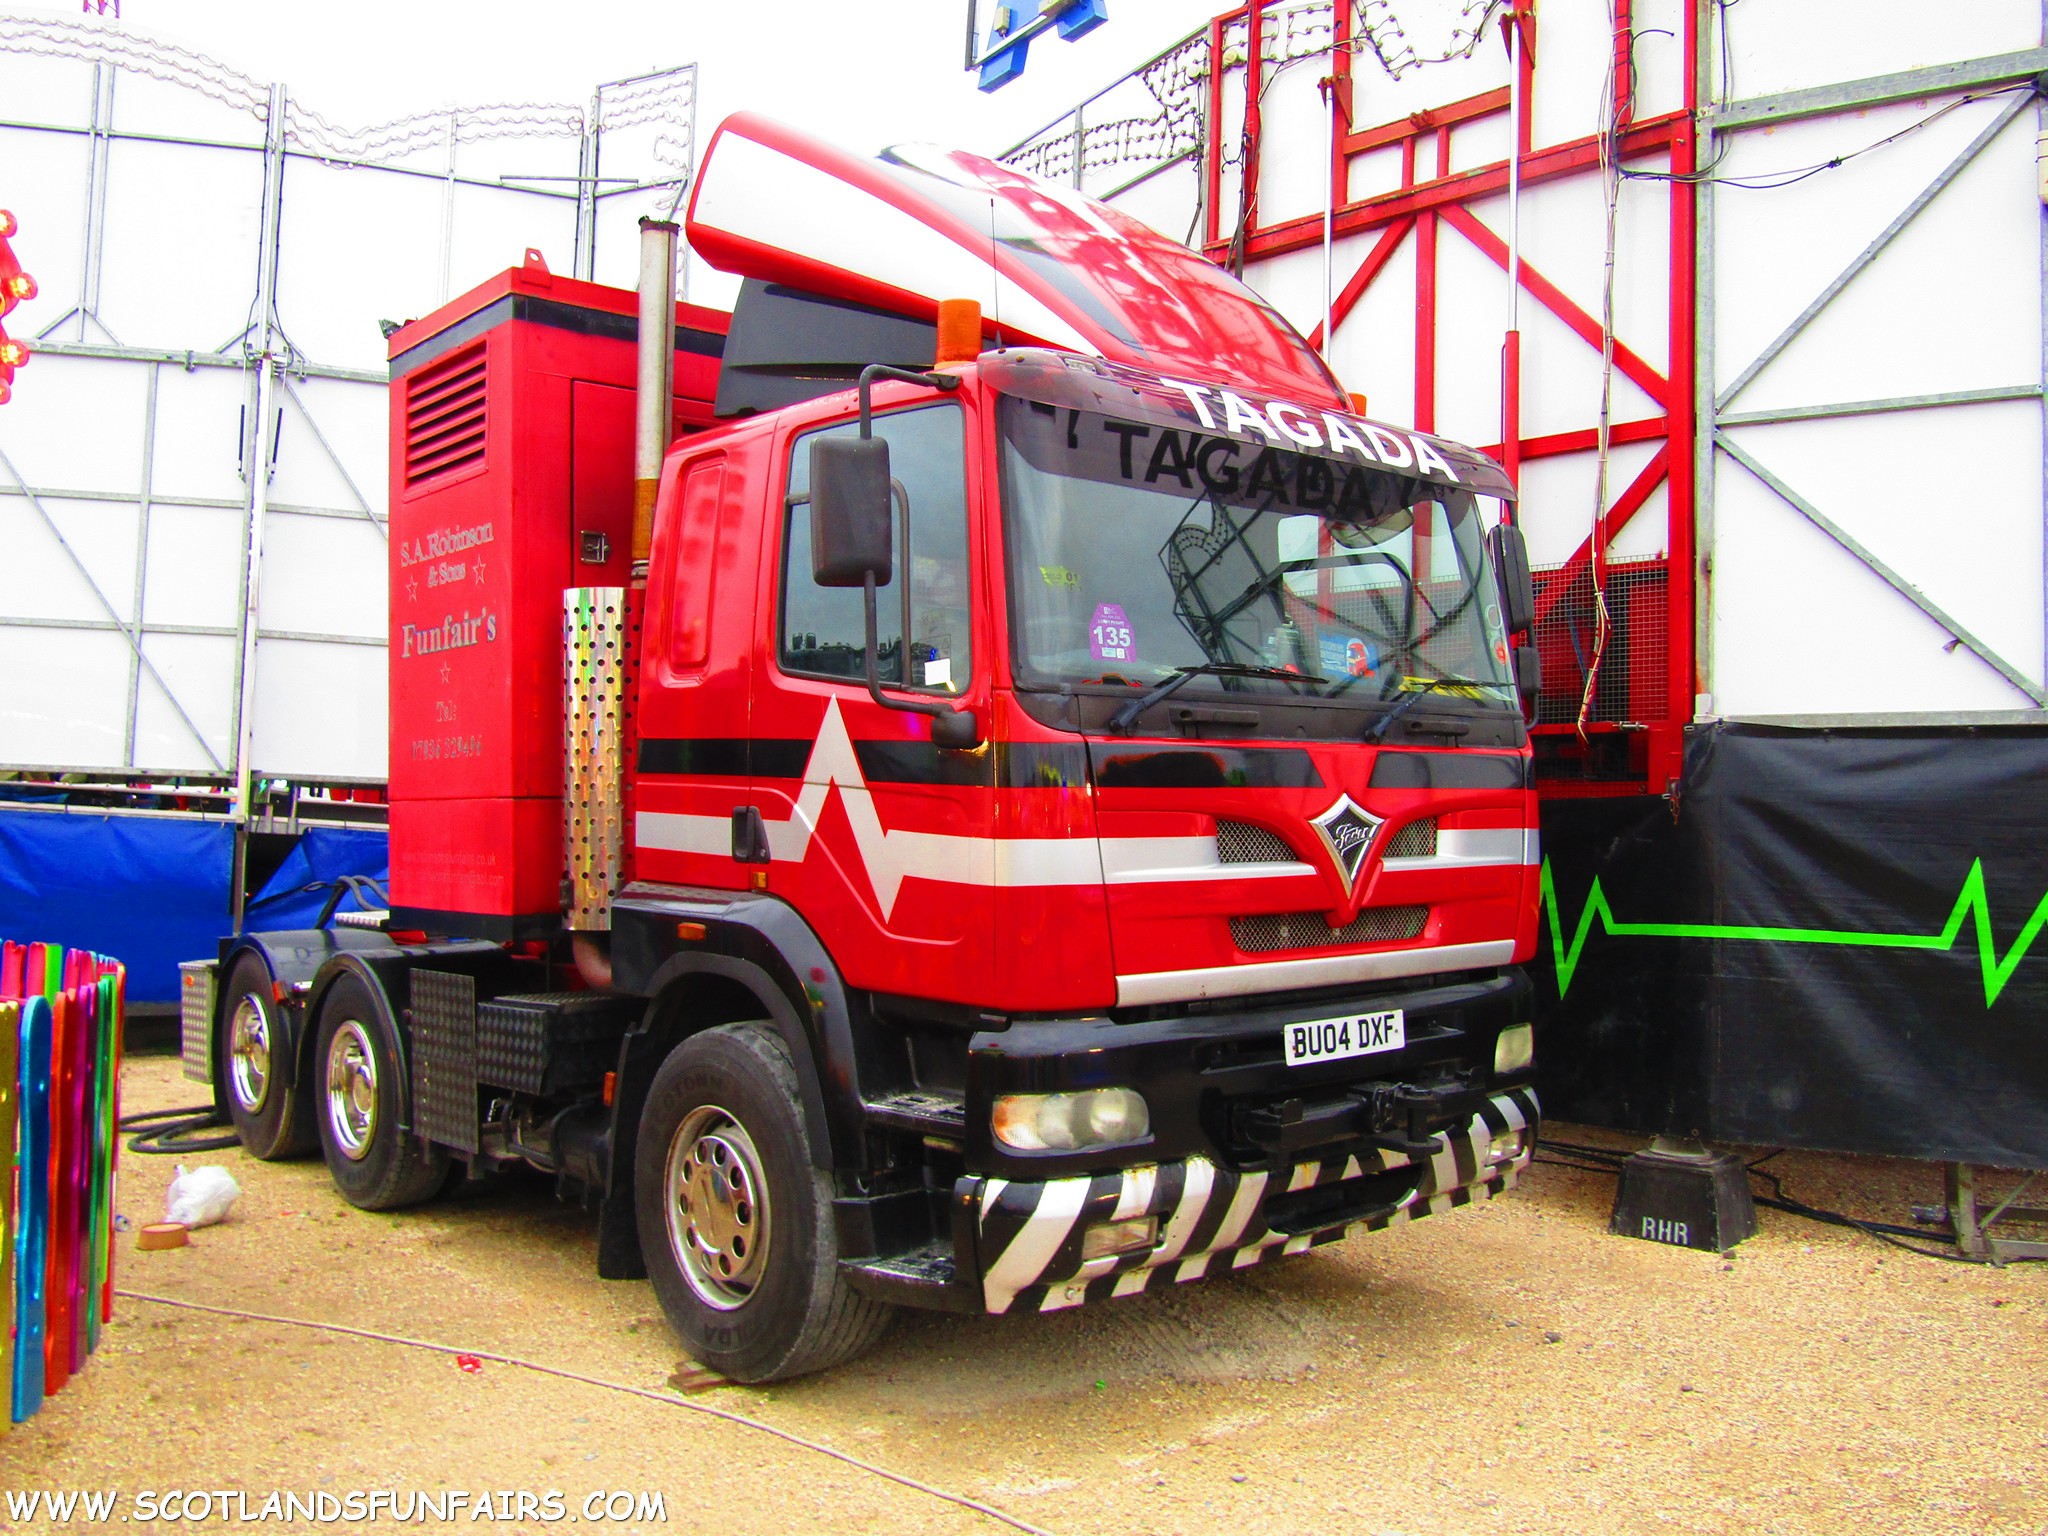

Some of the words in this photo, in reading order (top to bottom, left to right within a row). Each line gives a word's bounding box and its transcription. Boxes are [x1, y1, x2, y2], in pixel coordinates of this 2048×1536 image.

[1159, 381, 1462, 483] TAGADA
[400, 522, 495, 568] S.A.Robinson
[427, 564, 439, 588] &
[439, 561, 467, 585] Sons
[401, 606, 498, 659] Funfair's
[1093, 625, 1131, 647] 135
[1293, 1020, 1351, 1059] BU04
[1358, 1013, 1395, 1049] DXF
[1641, 1215, 1690, 1246] RHR
